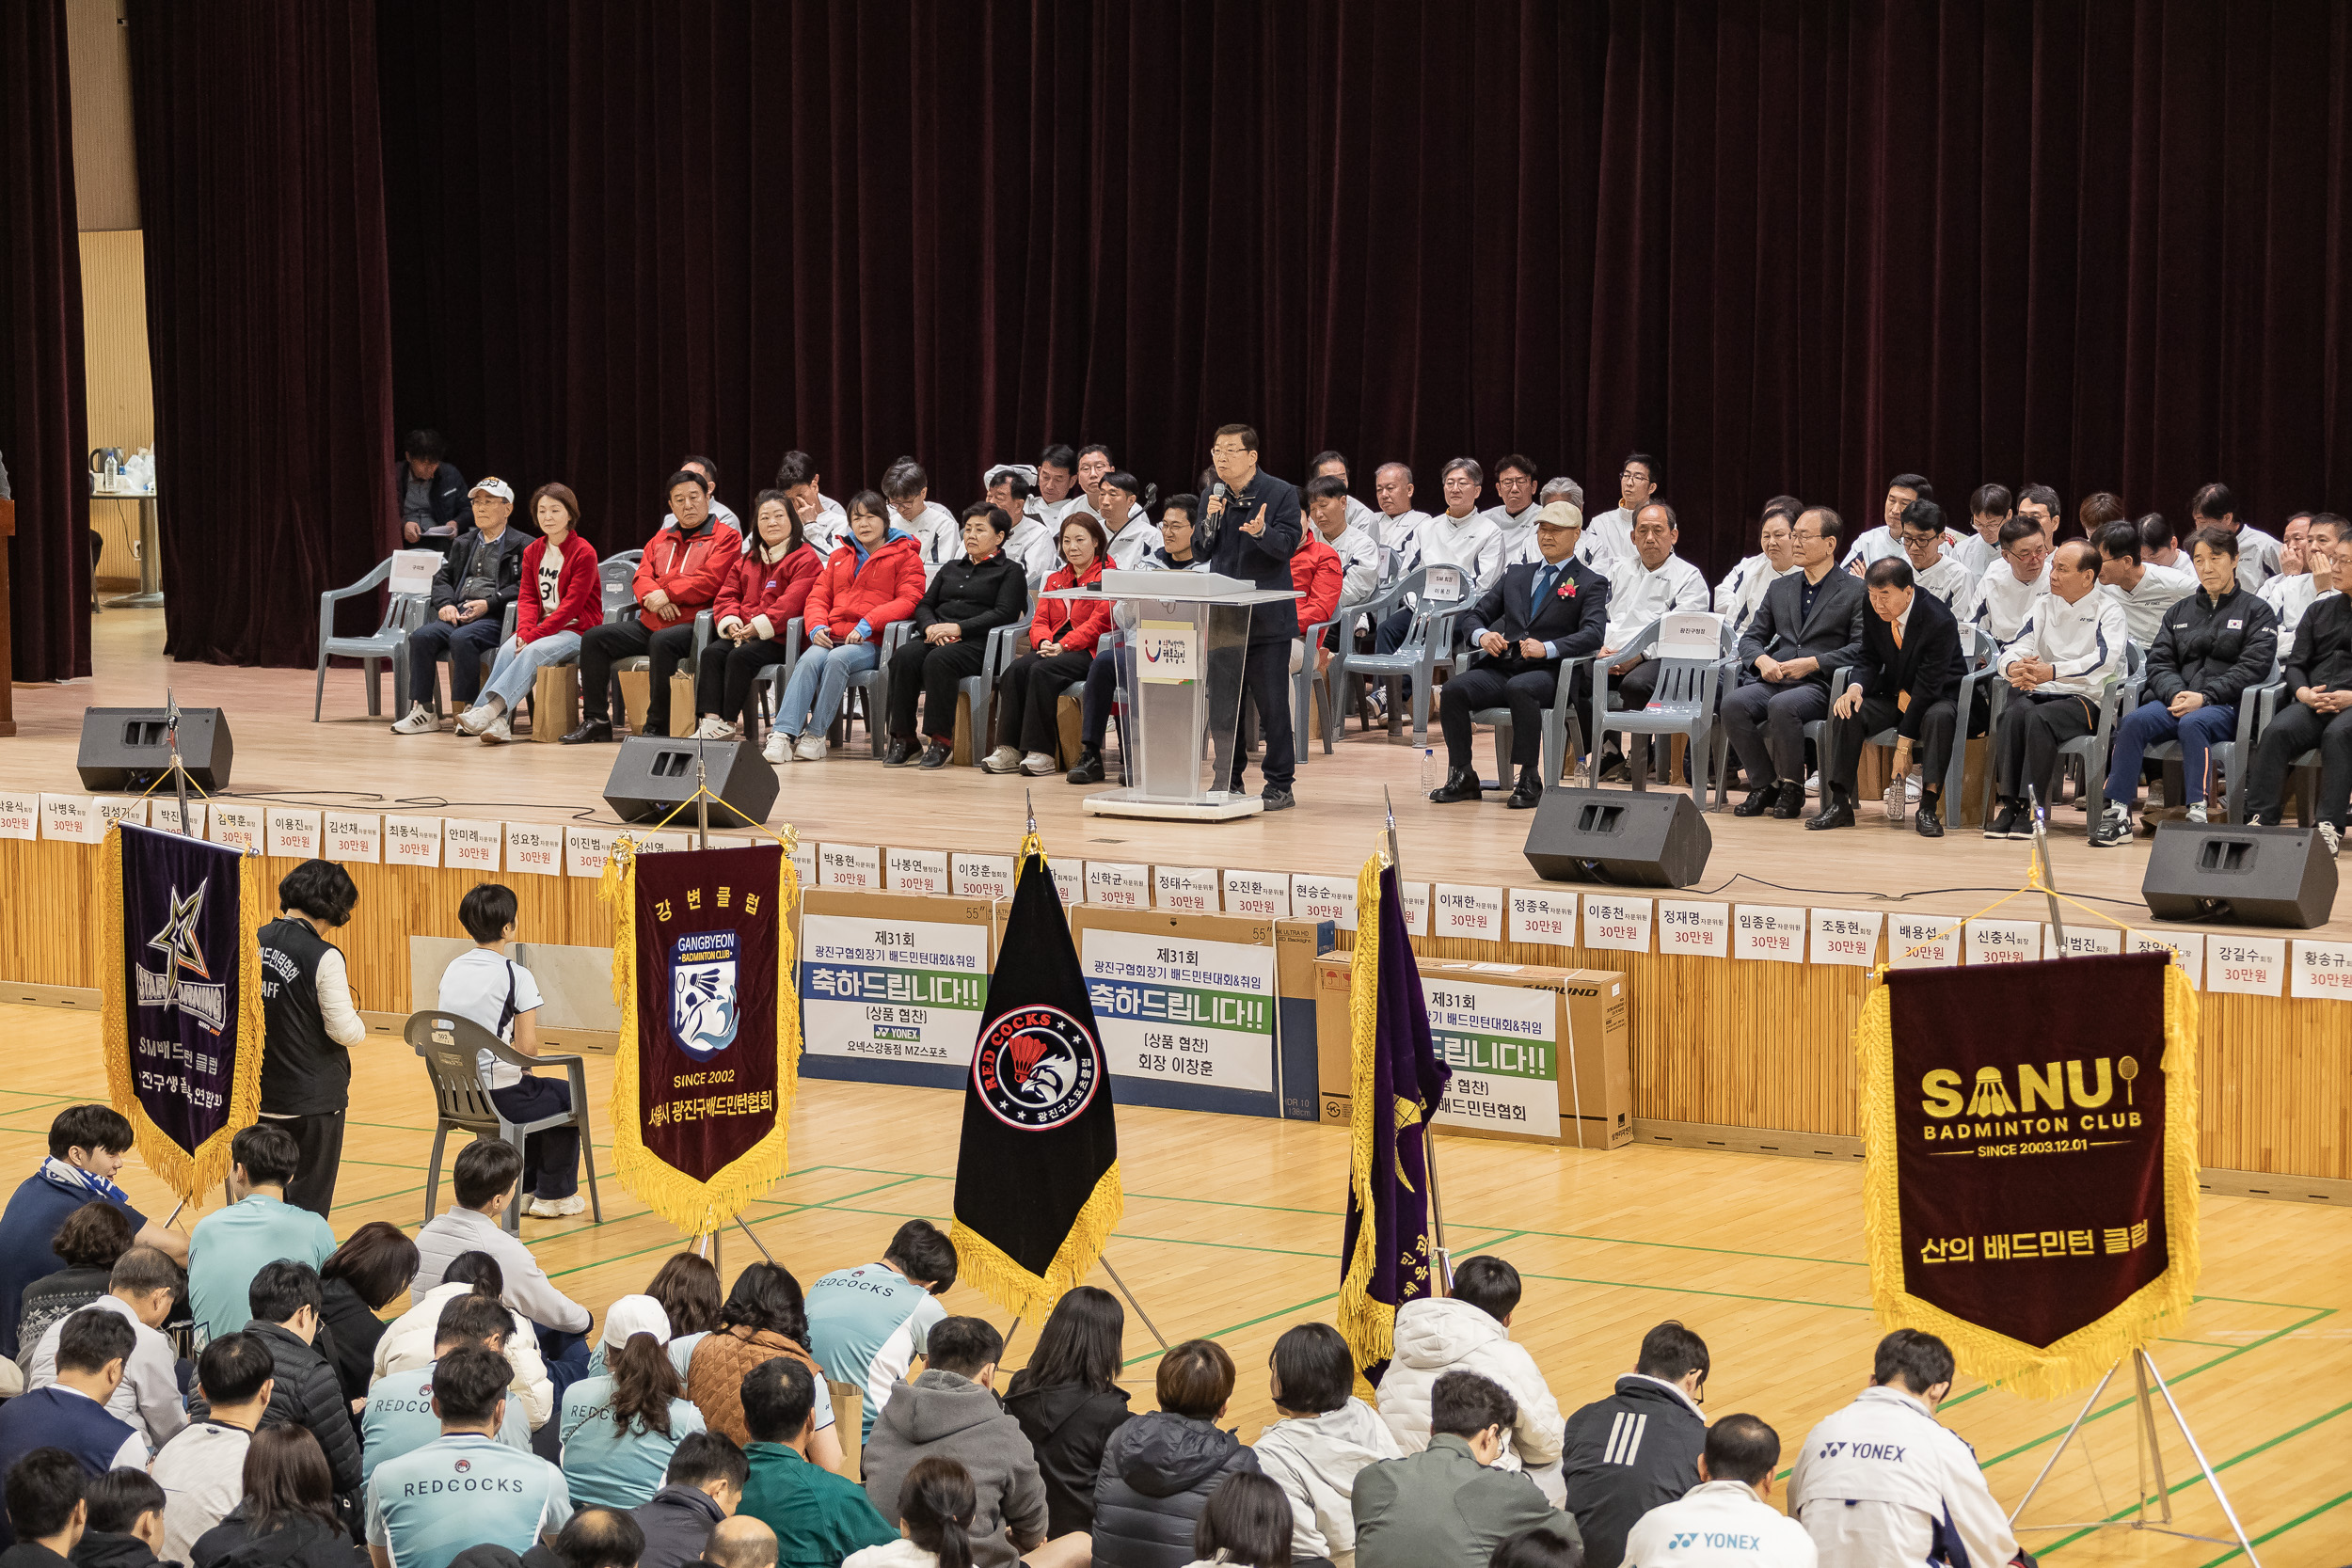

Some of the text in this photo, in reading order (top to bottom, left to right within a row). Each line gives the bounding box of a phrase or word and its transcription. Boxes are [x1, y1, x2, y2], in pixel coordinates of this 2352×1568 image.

[49, 802, 77, 816] 나병욱
[54, 820, 84, 833] 30만원
[275, 817, 304, 832] 이용진
[329, 821, 358, 835] 김선채
[389, 825, 419, 839] 최동식
[222, 831, 253, 843] 30만원
[280, 835, 310, 848] 30만원
[449, 829, 479, 842] 안미례
[510, 832, 539, 847] 성요창
[570, 836, 601, 850] 이진범
[339, 839, 369, 852] 30만원
[399, 843, 430, 856] 30만원
[458, 847, 489, 861] 30만원
[519, 851, 551, 864] 30만원
[824, 852, 854, 867] 박용현
[891, 858, 922, 873] 나봉연
[959, 863, 991, 878] 이창훈
[833, 872, 866, 886] 30만원
[900, 878, 934, 891] 30만원
[1090, 872, 1122, 886] 신학균
[1159, 876, 1192, 890] 정태수
[963, 882, 1004, 895] 500만원
[1229, 880, 1263, 895] 오진환
[1296, 884, 1331, 899] 현승순
[1101, 891, 1136, 905] 30만원
[1169, 895, 1205, 910] 30만원
[1440, 895, 1475, 909] 이재한
[1239, 900, 1275, 914] 30만원
[1307, 905, 1343, 919] 30만원
[1514, 898, 1549, 914] 정종옥
[1589, 905, 1624, 920] 이종천
[1451, 914, 1488, 928] 30만원
[1663, 911, 1700, 926] 정재명
[1740, 915, 1777, 930] 임종운
[1525, 920, 1563, 934] 30만원
[1598, 926, 1638, 940] 30만원
[1821, 920, 1859, 936] 조동현
[1899, 925, 1937, 941] 배용섭
[678, 933, 735, 952] GANGBYEON
[874, 930, 914, 947] 제31회
[1675, 931, 1714, 945] 30만원
[1751, 936, 1790, 950] 30만원
[1978, 930, 2016, 946] 신충식
[2063, 937, 2095, 952] 범진
[1827, 940, 1867, 955] 30만원
[1904, 945, 1945, 960] 30만원
[2219, 946, 2260, 962] 강길수
[681, 950, 730, 962] BADMINTON CLUB
[815, 945, 976, 967] 광진구협회장기 배드민턴대회&취임
[1156, 947, 1200, 966] 제31회
[1983, 950, 2024, 964] 30만원
[2304, 951, 2346, 968] 황송규
[1094, 960, 1261, 990] 광진구협회장기 배드민턴대회&취임
[2224, 968, 2267, 983] 30만원
[262, 981, 280, 999] AFF
[812, 968, 977, 1006] 축하드립니다!!
[1090, 983, 1263, 1029] 축하드립니다!!
[1432, 991, 1475, 1010] 제31회
[1447, 1013, 1542, 1035] 배드민턴대회&취임
[891, 1028, 918, 1040] YONEX
[848, 1040, 947, 1058] 요넥스강동점 MZ스포츠
[982, 1013, 1052, 1091] RED COCKS
[1138, 1053, 1214, 1077] 회장 이창훈
[674, 1069, 735, 1088] SINCE 2002
[1037, 1058, 1091, 1122] 광진구스포츠클럽
[1300, 1098, 1310, 1108] 10
[1438, 1097, 1526, 1121] 배드민턴협회
[1923, 1112, 2142, 1140] BADMINTON CLUB
[1978, 1139, 2088, 1157] SINCE 2003.12.01
[1920, 1219, 2149, 1263] 산의 배드민턴 클럽
[815, 1276, 894, 1297] REDCOCKS
[374, 1398, 430, 1414] REDCO
[1851, 1442, 1906, 1464] YONEX
[404, 1478, 524, 1497] REDCOCKS
[1704, 1532, 1760, 1552] YONEX
